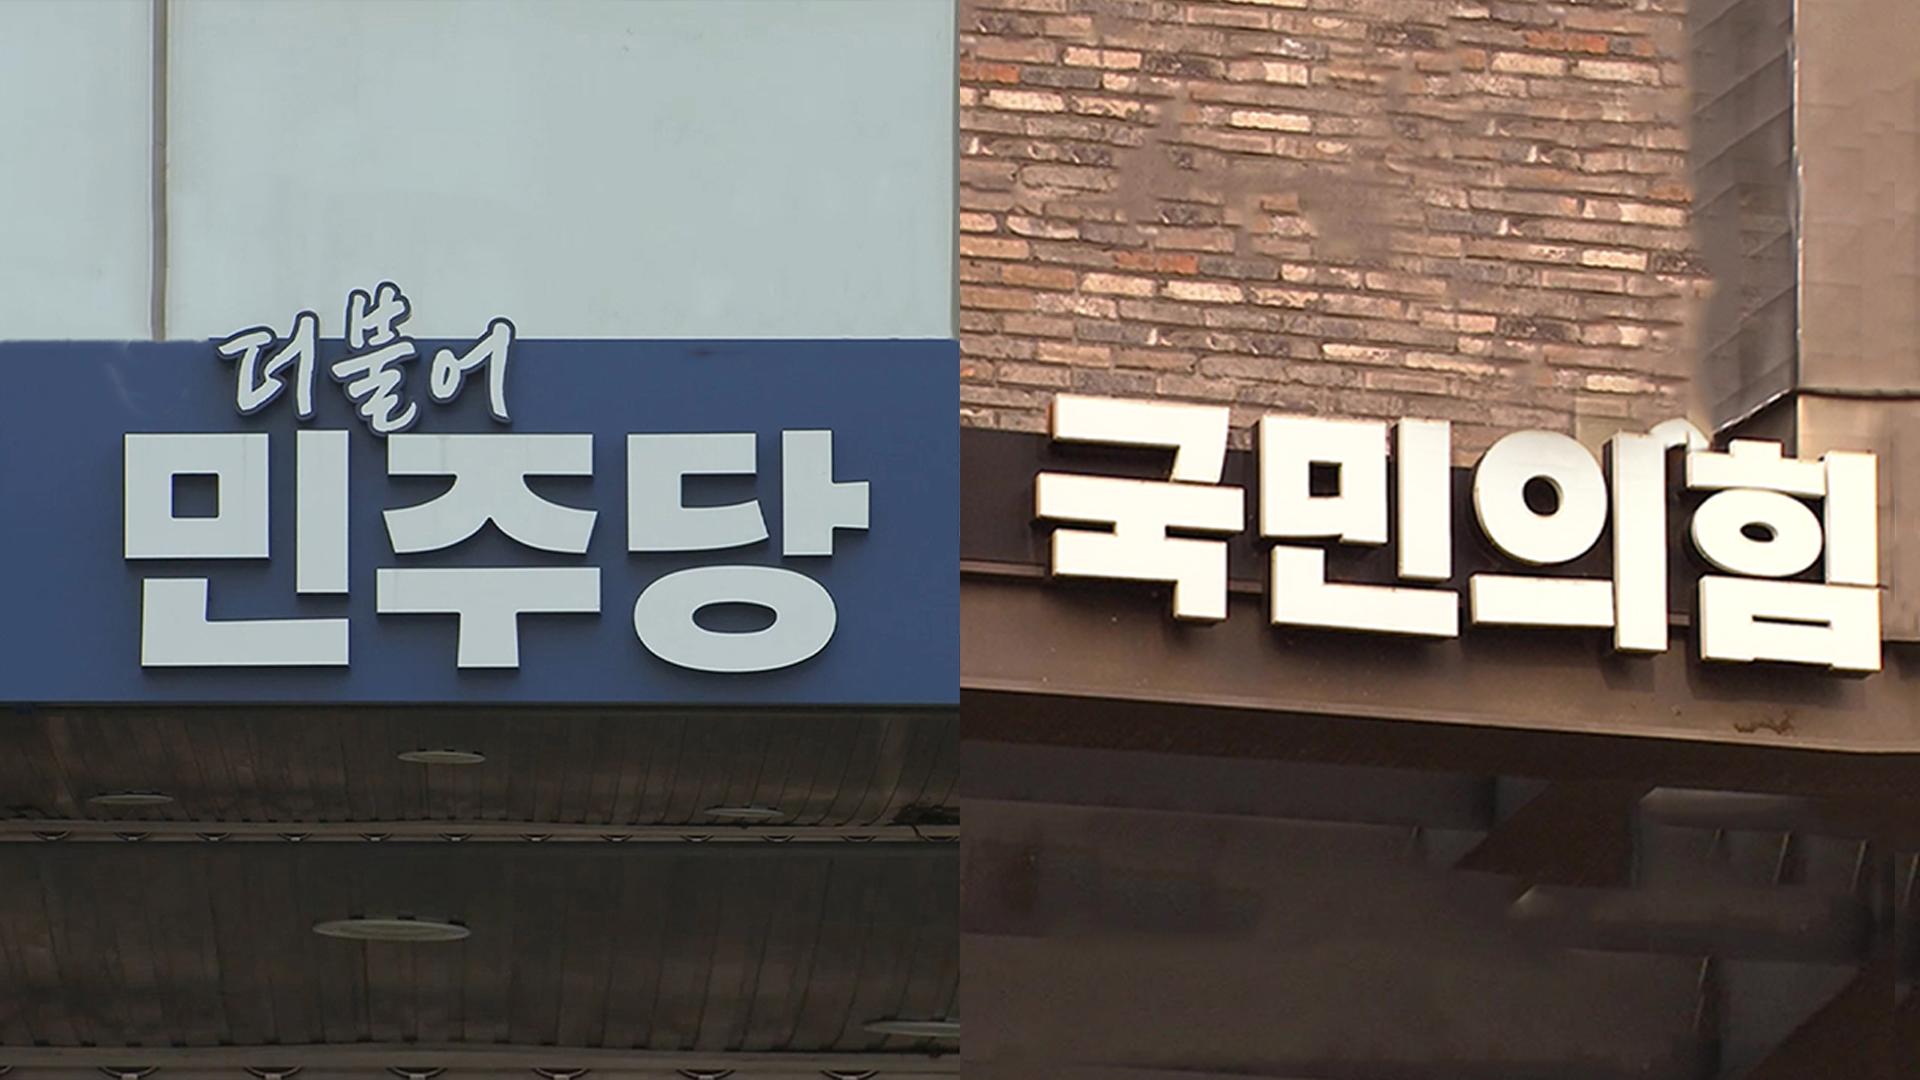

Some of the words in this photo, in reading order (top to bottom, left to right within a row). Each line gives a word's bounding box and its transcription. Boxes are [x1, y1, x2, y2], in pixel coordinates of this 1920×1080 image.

[218, 283, 515, 434] 더불어
[124, 429, 870, 672] 민주당
[1036, 393, 1881, 673] 국민의힘
